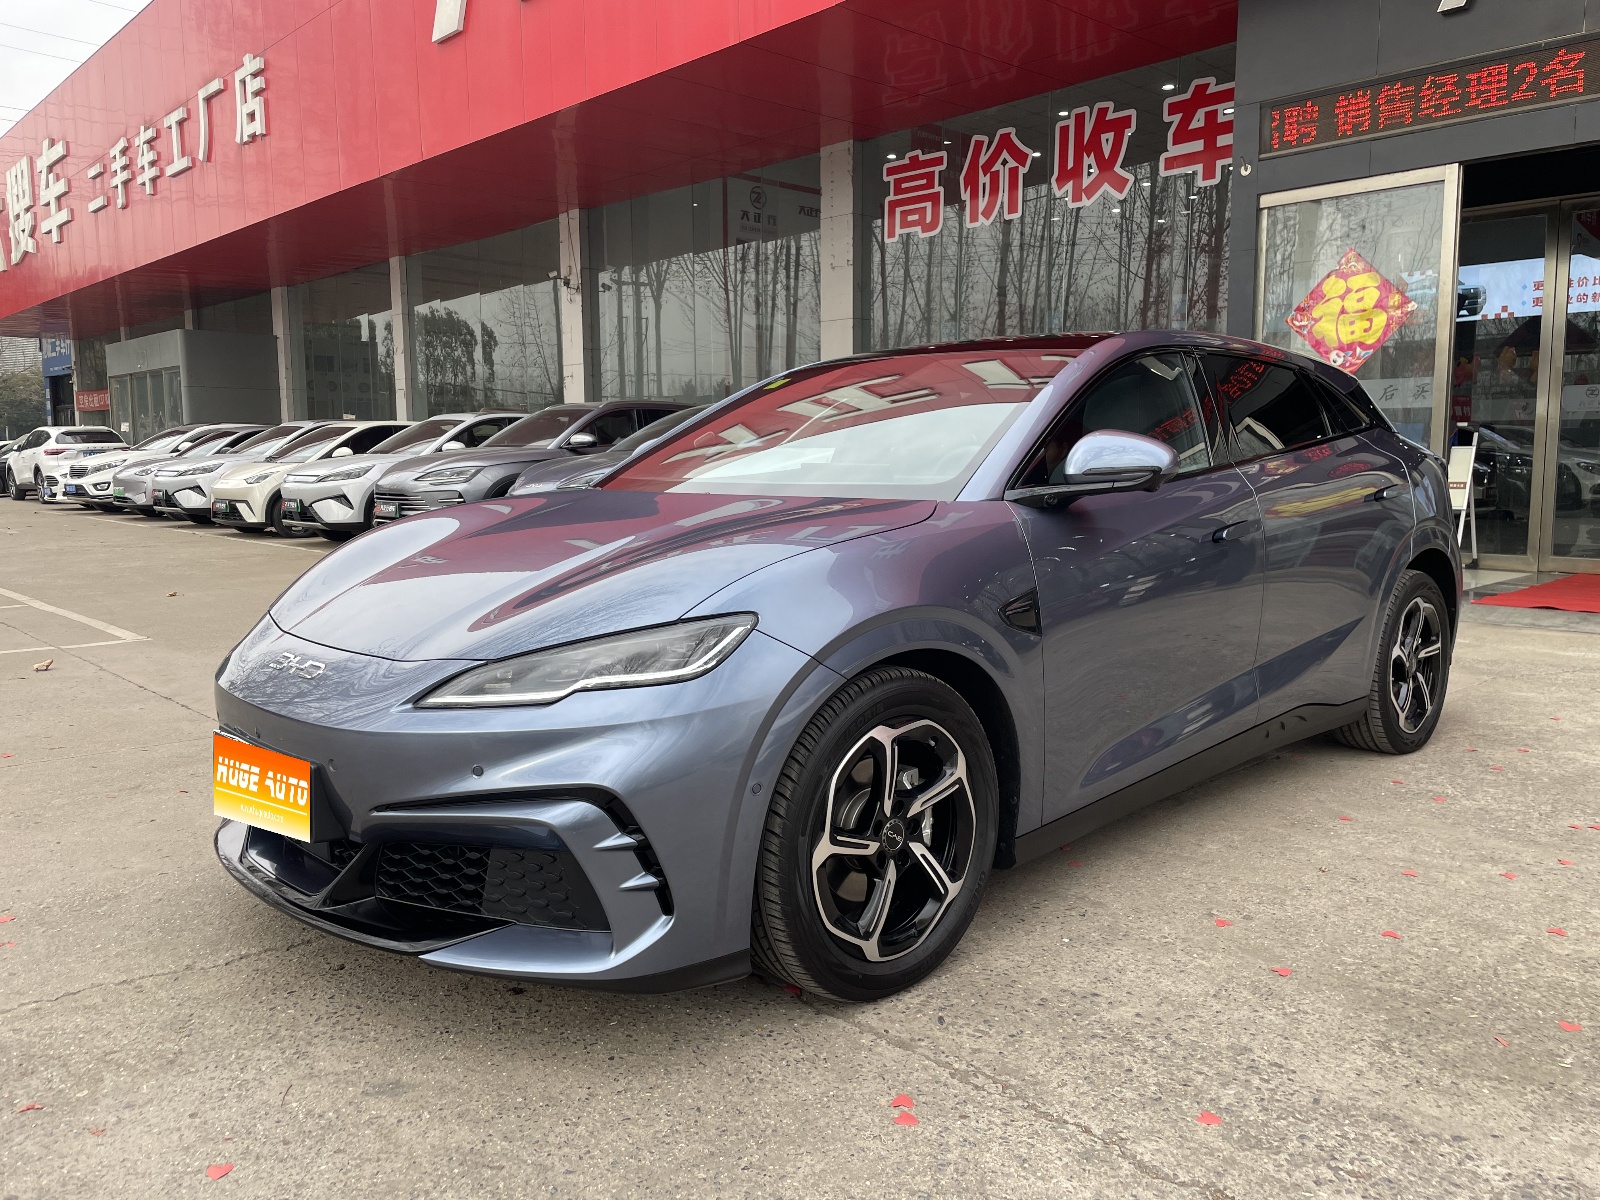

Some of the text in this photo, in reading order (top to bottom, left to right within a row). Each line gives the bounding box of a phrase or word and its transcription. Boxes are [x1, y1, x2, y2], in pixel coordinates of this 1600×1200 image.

[1334, 48, 1586, 137] 销售经理2名
[0, 53, 267, 272] 搜车 二手车工厂店
[883, 77, 1235, 243] 高价收车
[1311, 271, 1388, 348] 福
[268, 652, 326, 680] BYD
